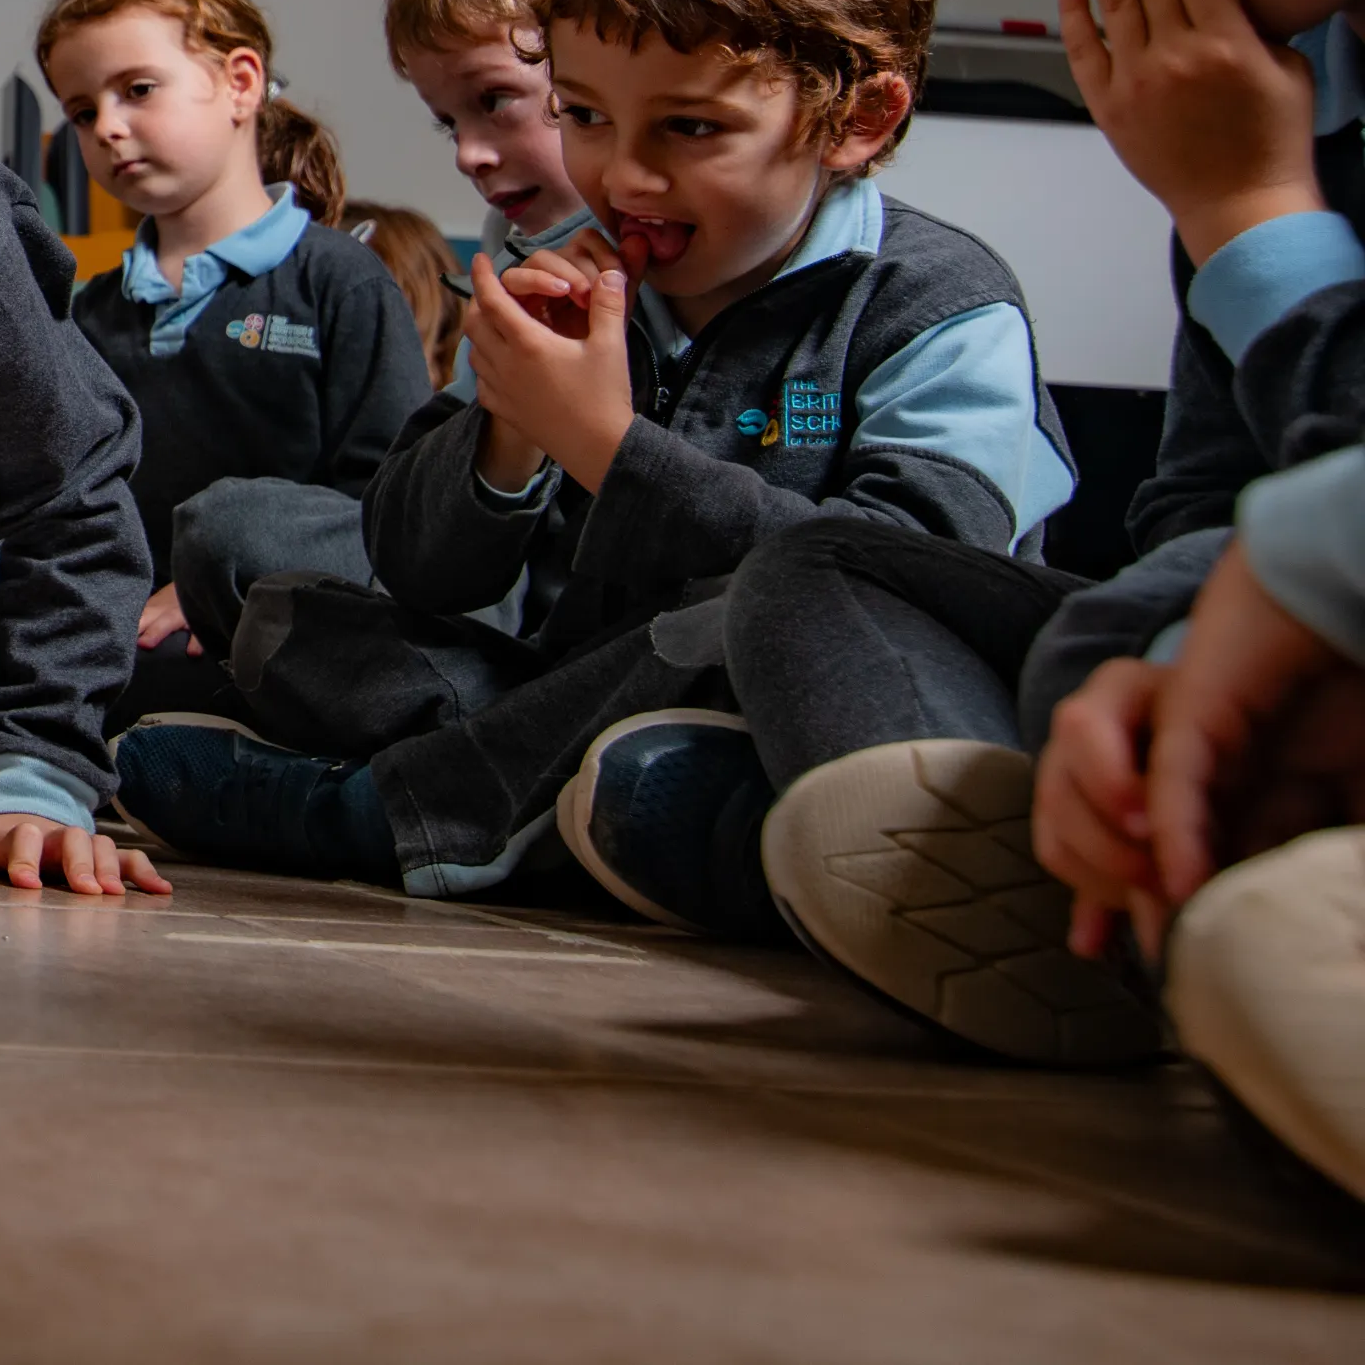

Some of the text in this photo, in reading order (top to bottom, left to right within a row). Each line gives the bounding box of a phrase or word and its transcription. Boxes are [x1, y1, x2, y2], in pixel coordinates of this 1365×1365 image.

[789, 379, 819, 391] THE
[791, 392, 841, 410] BRITI
[791, 414, 842, 431] SCH
